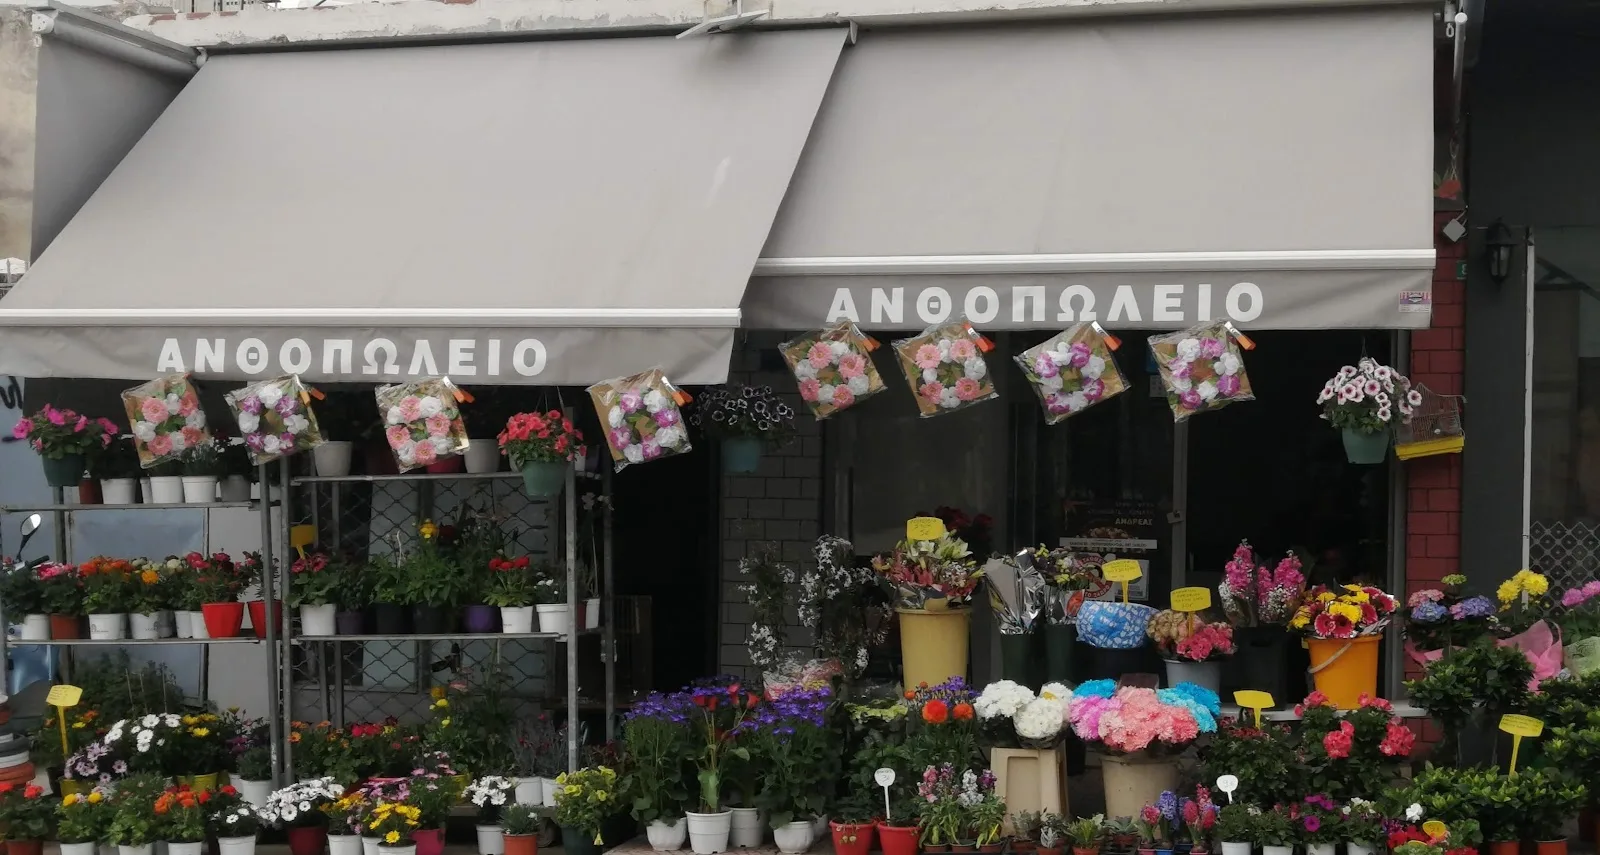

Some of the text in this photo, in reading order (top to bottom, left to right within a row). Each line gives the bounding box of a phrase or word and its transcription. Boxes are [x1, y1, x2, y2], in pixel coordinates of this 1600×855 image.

[826, 281, 1263, 322] ΑΝΘΟΠΩΛΕΙΟ
[157, 338, 547, 377] ΑΝΘΟΠΩΛΕΙΟ
[1115, 517, 1153, 526] ΑΝΔΡΕΑΣ
